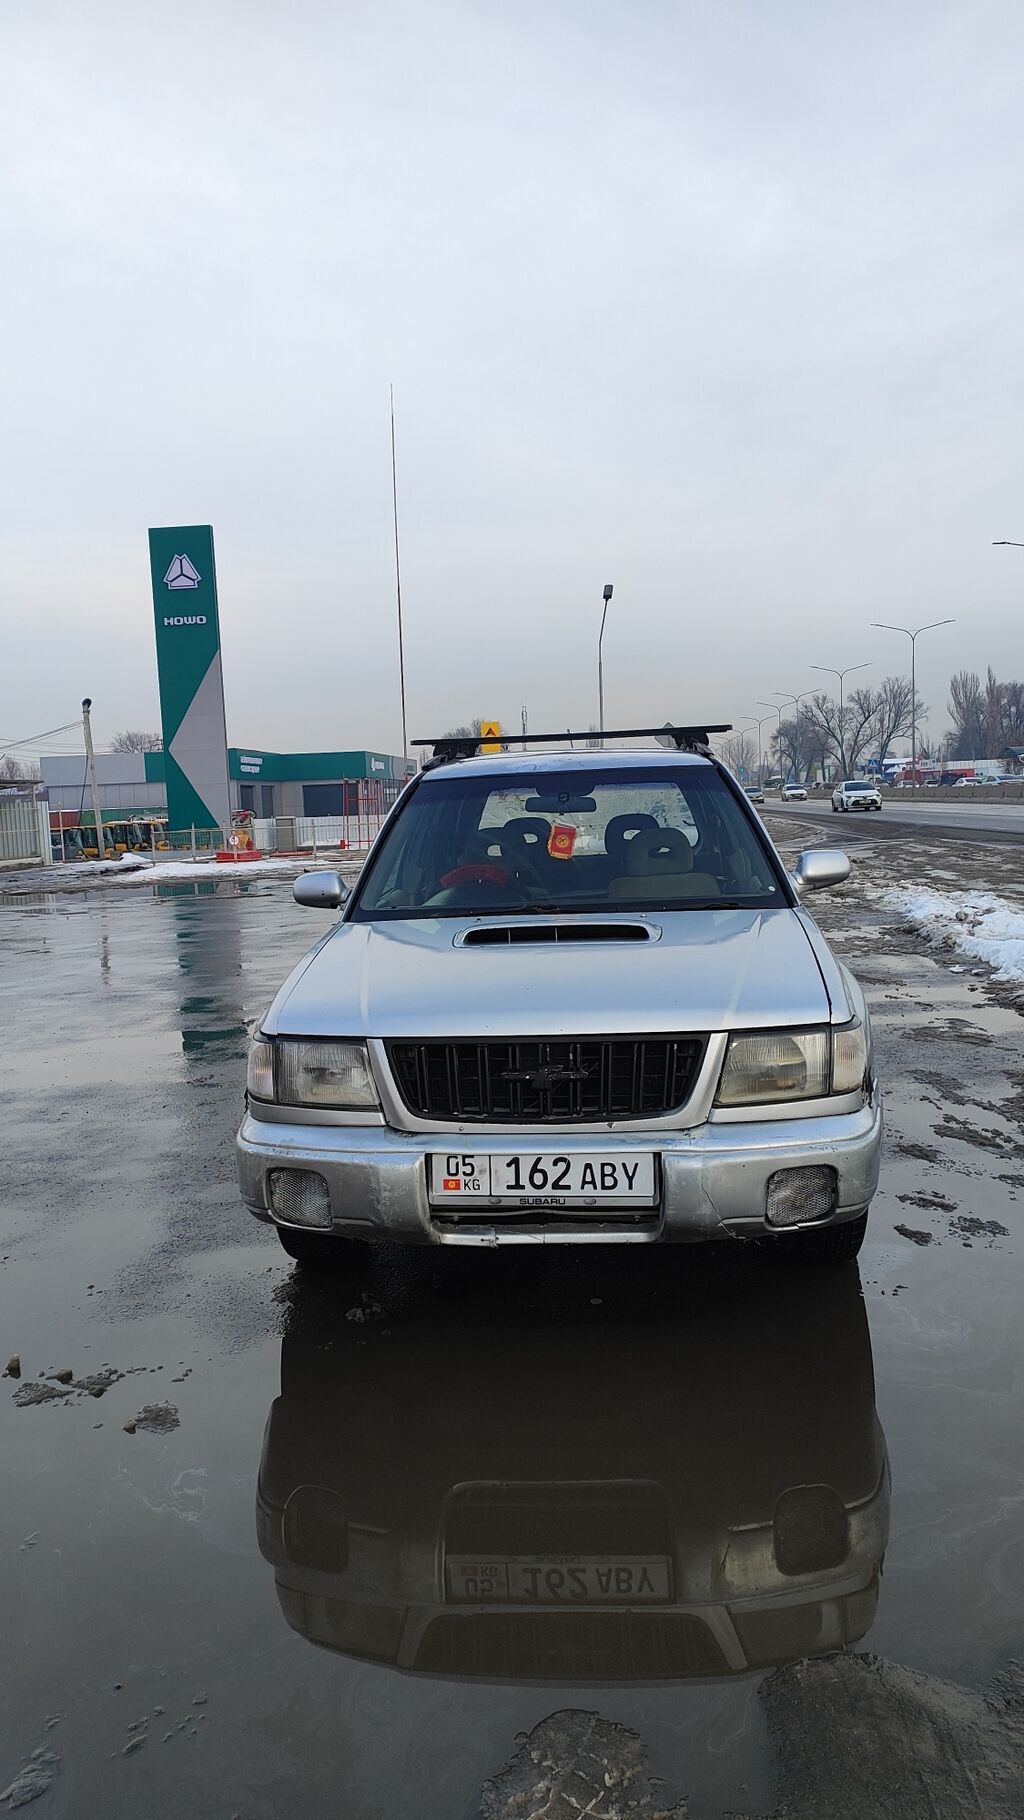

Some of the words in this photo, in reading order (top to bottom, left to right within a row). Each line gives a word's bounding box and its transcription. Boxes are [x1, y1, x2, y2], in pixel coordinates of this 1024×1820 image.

[163, 615, 207, 626] HOWO
[446, 1155, 475, 1177] 05
[505, 1156, 572, 1191] 162
[580, 1162, 639, 1191] ABY
[463, 1178, 481, 1191] KG
